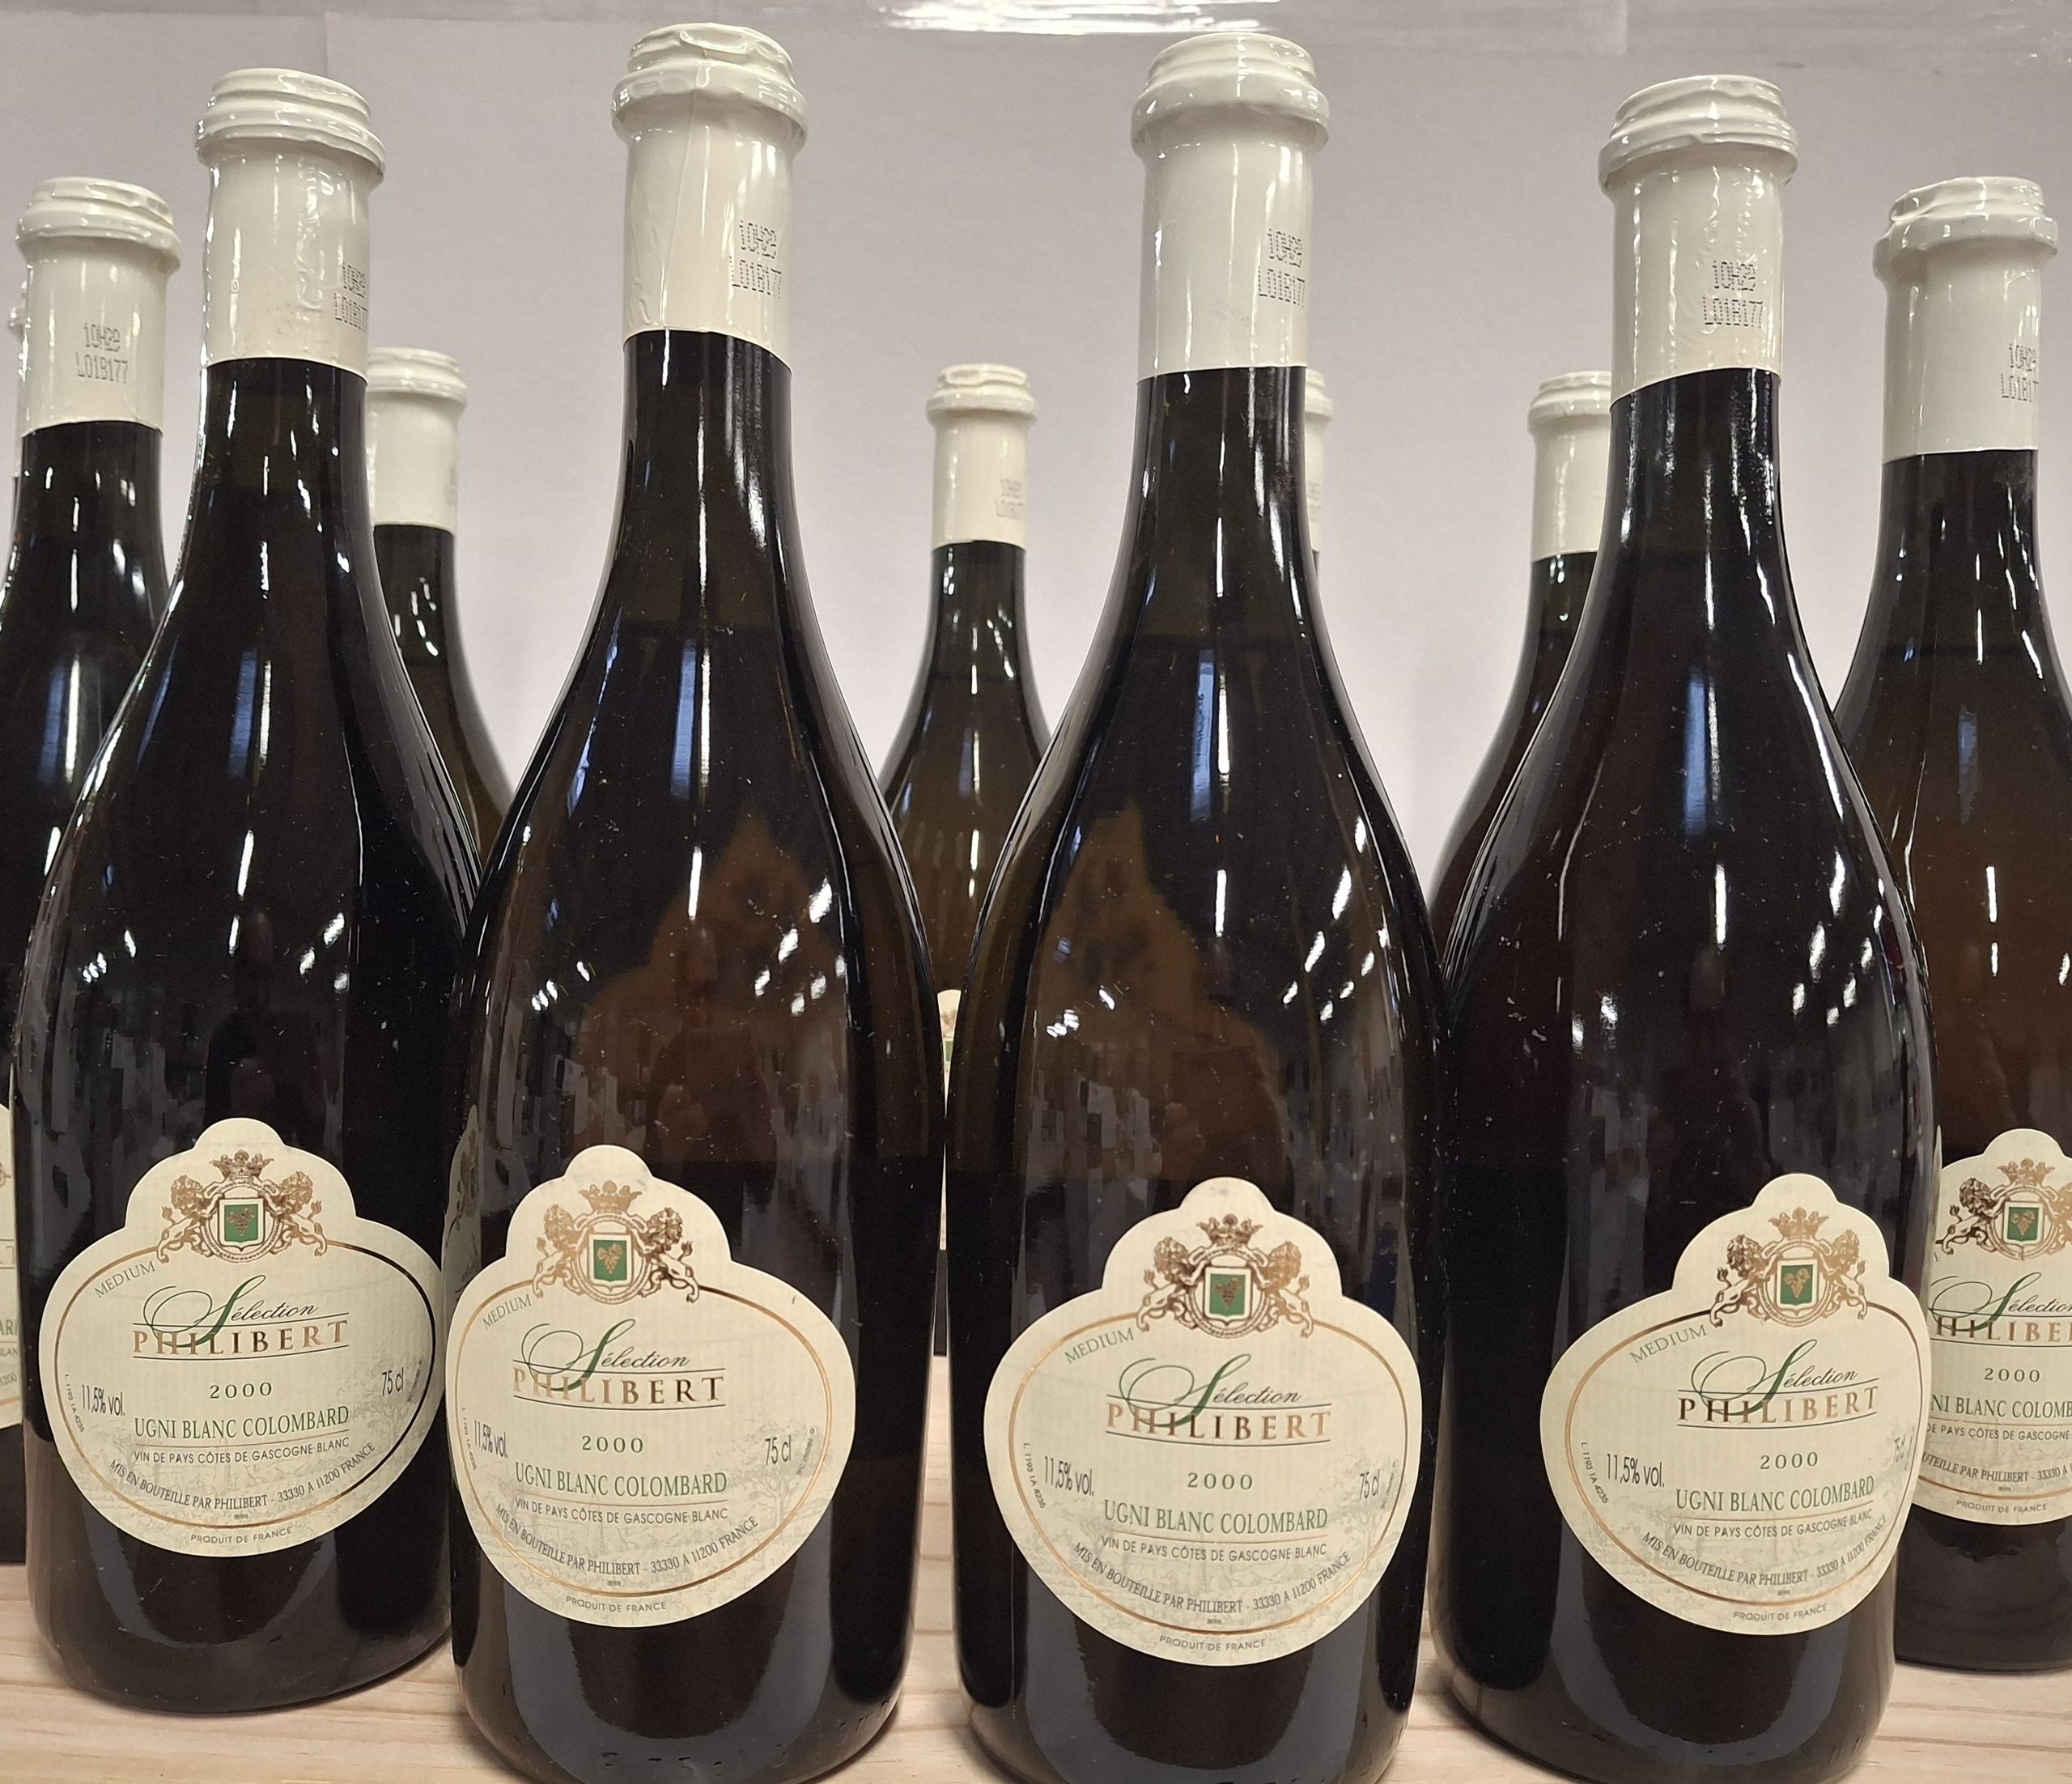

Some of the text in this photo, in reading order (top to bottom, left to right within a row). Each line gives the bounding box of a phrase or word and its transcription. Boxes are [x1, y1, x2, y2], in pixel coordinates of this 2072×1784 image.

[94, 1260, 156, 1298] MEDIUM
[143, 1275, 318, 1347] Sélection
[482, 1293, 532, 1329] MEDIUM
[132, 1319, 348, 1355] PHILIBERT
[1064, 1327, 1134, 1364] MEDIUM
[1628, 1324, 1707, 1363] MEDIUM
[1936, 1317, 2072, 1342] HILIBE
[521, 1319, 690, 1391] Sélection
[210, 1382, 272, 1400] 2000
[381, 1370, 393, 1397] 75
[395, 1366, 404, 1392] cl
[512, 1367, 724, 1404] PHILIBERT
[1119, 1353, 1302, 1427] Sélection
[1691, 1339, 1858, 1416] Sélection
[1984, 1367, 2040, 1383] 2000
[1106, 1402, 1331, 1440] PHILIBERT
[1677, 1386, 1878, 1424] PHILIBERT
[1931, 1394, 2072, 1418] NI BLANC COLOMB
[134, 1405, 349, 1438] UGNI BLANC COLOMBARD
[1940, 1425, 1965, 1436] PAYS
[2002, 1430, 2015, 1440] DE
[2018, 1430, 2070, 1440] GASCOGNE
[134, 1451, 150, 1462] VIN
[154, 1452, 165, 1463] DE
[169, 1453, 193, 1463] PAYS
[236, 1451, 247, 1462] DE
[252, 1444, 313, 1461] GASCOGNE
[316, 1437, 350, 1452] BLANC
[581, 1435, 643, 1454] 2000
[764, 1437, 779, 1466] 75
[781, 1434, 792, 1462] cl
[1760, 1451, 1819, 1470] 2000
[109, 1459, 127, 1477] MIS
[125, 1471, 139, 1486] EN
[139, 1479, 190, 1506] BOUTEILLE
[193, 1496, 211, 1509] PAR
[214, 1494, 268, 1510] PHILIBERT
[308, 1482, 315, 1492] A
[316, 1468, 340, 1488] 11200
[340, 1442, 375, 1474] FRANCE
[515, 1462, 727, 1497] UGNI BLANC COLOMBARD
[1187, 1472, 1253, 1490] 2000
[1921, 1452, 1958, 1473] UTEILLE
[1959, 1465, 1979, 1479] PAR
[1981, 1470, 2028, 1482] PHILIBERT
[1360, 1472, 1369, 1500] 75
[1371, 1468, 1380, 1497] cl
[1675, 1475, 1874, 1512] UGNI BLANC COLOMBARD
[515, 1497, 529, 1510] VIN
[532, 1502, 542, 1514] DE
[546, 1504, 567, 1519] PAYS
[607, 1513, 619, 1523] DE
[624, 1511, 688, 1524] GASCOGNE
[692, 1508, 728, 1522] BLANC
[1104, 1499, 1327, 1534] UGNI BLANC COLOMBARD
[1673, 1523, 1692, 1535] VIN
[1696, 1525, 1709, 1537] DE
[1714, 1526, 1740, 1537] PAYS
[1781, 1525, 1793, 1536] DE
[1797, 1518, 1849, 1535] GASCOGNE
[1849, 1508, 1873, 1526] BLANC
[1956, 1500, 1995, 1512] PRODUIT
[2013, 1503, 2047, 1513] FRANCE
[190, 1527, 292, 1544] PRODUIT DE FRANCE
[495, 1503, 509, 1523] MIS
[508, 1518, 521, 1536] EN
[520, 1529, 566, 1564] BOUTEILLE
[567, 1554, 585, 1571] PAR
[588, 1560, 640, 1575] PHILIBERT
[682, 1553, 690, 1565] A
[691, 1542, 719, 1562] 11200
[719, 1515, 759, 1549] FRANCE
[1102, 1536, 1119, 1548] VIN
[1123, 1540, 1136, 1553] DE
[1140, 1543, 1167, 1557] PAYS
[1211, 1550, 1224, 1561] DE
[1229, 1548, 1290, 1561] GASCOGNE
[1295, 1543, 1327, 1559] BLANC
[1641, 1531, 1660, 1552] MIS
[1662, 1545, 1679, 1561] EN
[1679, 1554, 1735, 1582] BOUTEILLE
[1736, 1571, 1756, 1586] PAR
[1759, 1569, 1808, 1586] PHILIBERT
[1841, 1556, 1846, 1568] A
[1847, 1542, 1865, 1564] 11200
[1864, 1514, 1887, 1547] FRANCE
[1073, 1542, 1090, 1563] MIS
[1091, 1557, 1107, 1574] EN
[1106, 1568, 1161, 1603] BOUTEILLE
[1162, 1593, 1183, 1609] PAR
[1186, 1598, 1242, 1613] PHILIBERT
[1284, 1591, 1291, 1602] A
[1292, 1578, 1316, 1599] 11200
[1316, 1551, 1351, 1585] FRANCE
[566, 1595, 667, 1612] PRODUIT DE FRANCE
[1733, 1603, 1828, 1620] PRODUIT DE FRANCE
[1159, 1635, 1265, 1651] PRODUIT DE FRANCE
